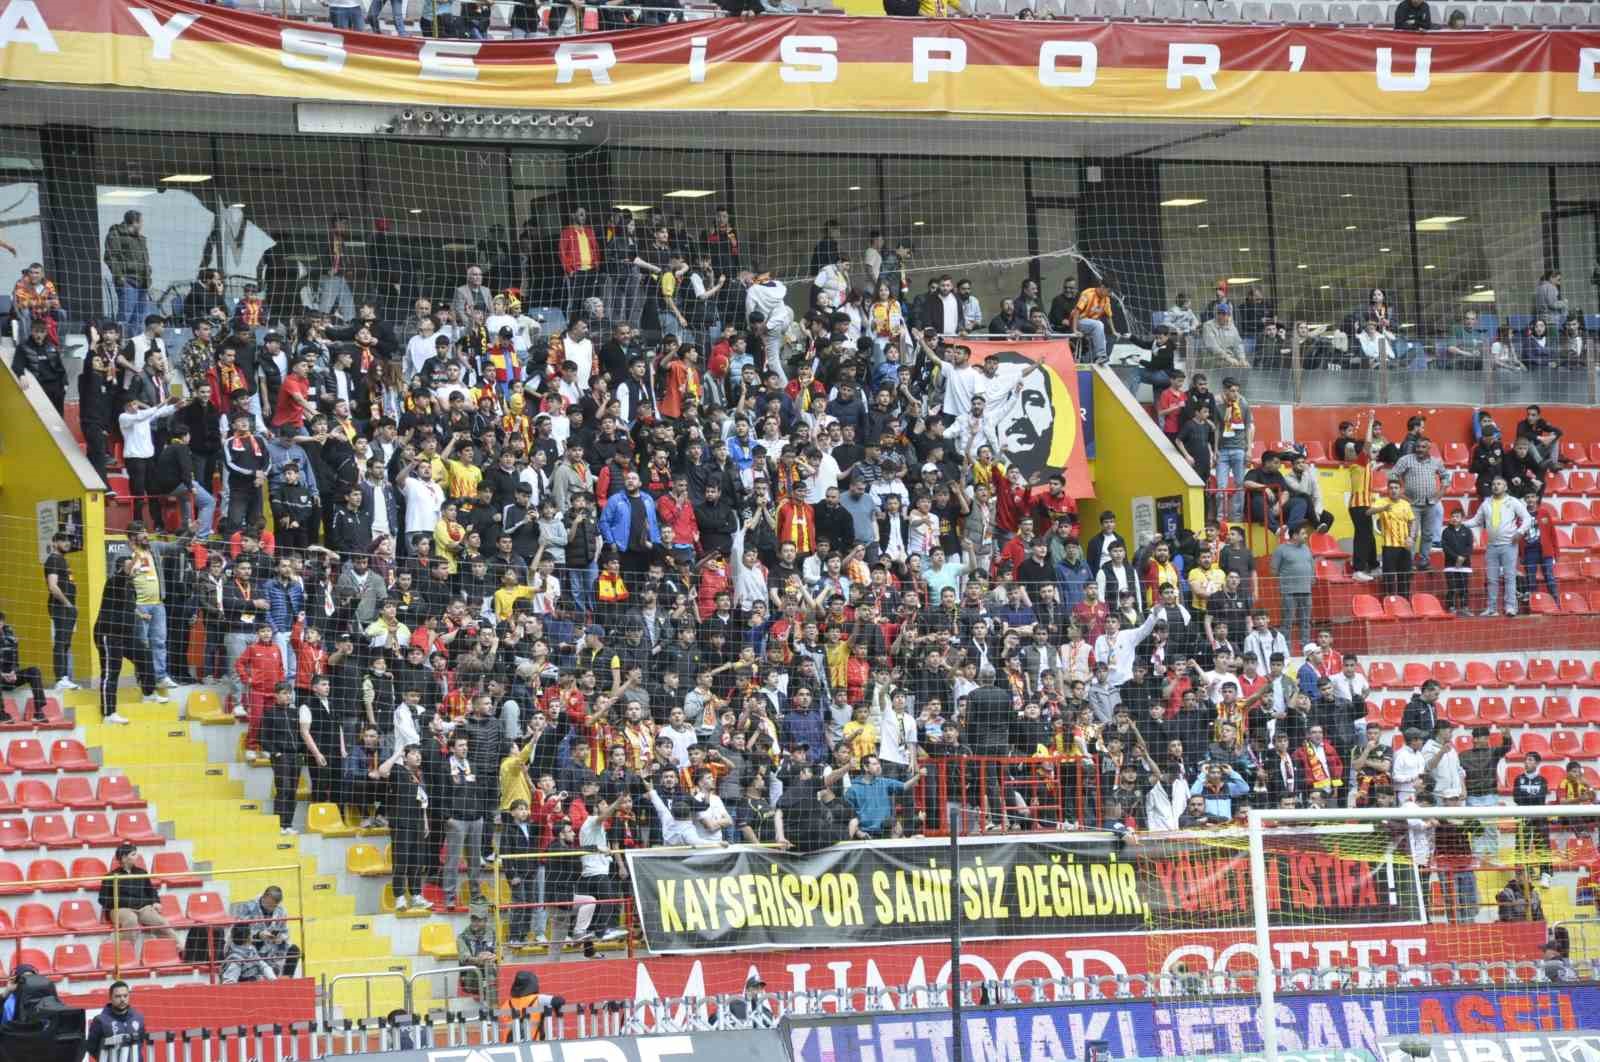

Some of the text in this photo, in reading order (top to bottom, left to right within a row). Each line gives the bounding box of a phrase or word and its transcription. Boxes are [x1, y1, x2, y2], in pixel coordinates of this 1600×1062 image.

[658, 864, 864, 933] KAYSERİSPOR
[1015, 851, 1150, 921] DEĞİLDİR,
[1156, 849, 1281, 913] YÖNETM
